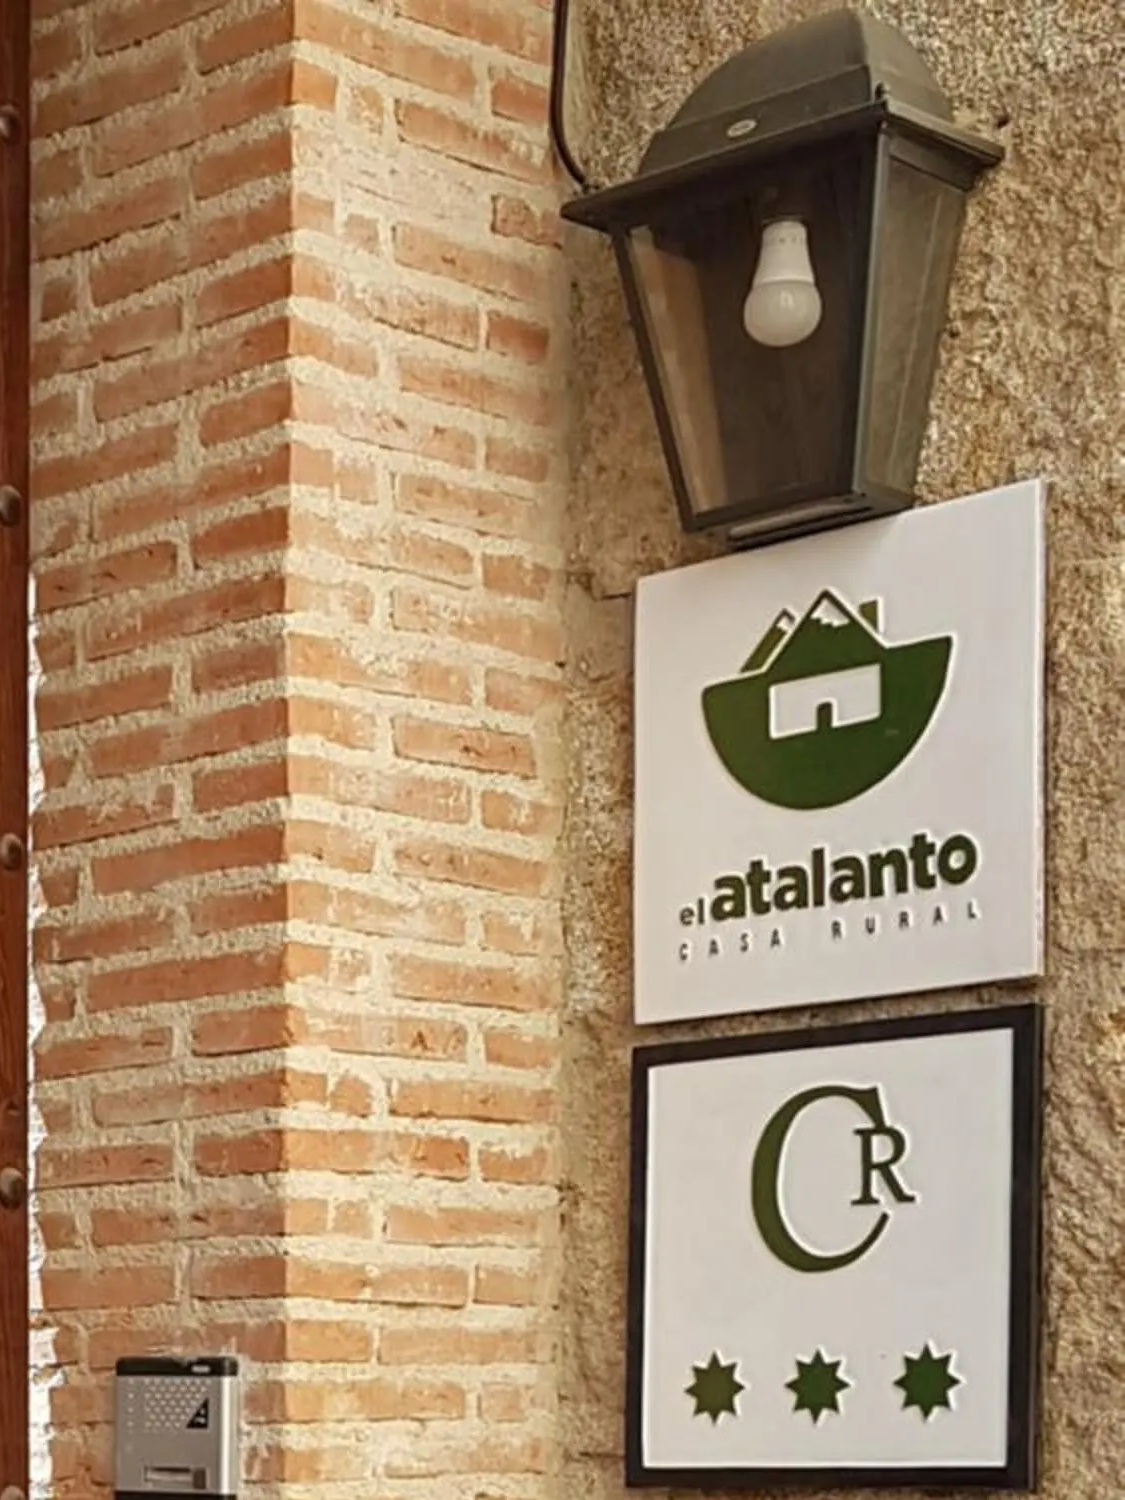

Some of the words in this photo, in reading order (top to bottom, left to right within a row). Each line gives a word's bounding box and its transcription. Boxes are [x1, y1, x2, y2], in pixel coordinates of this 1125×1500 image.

[679, 898, 705, 926] el
[710, 832, 977, 921] atalanto
[679, 928, 782, 961] CASA
[831, 901, 978, 940] RURAL
